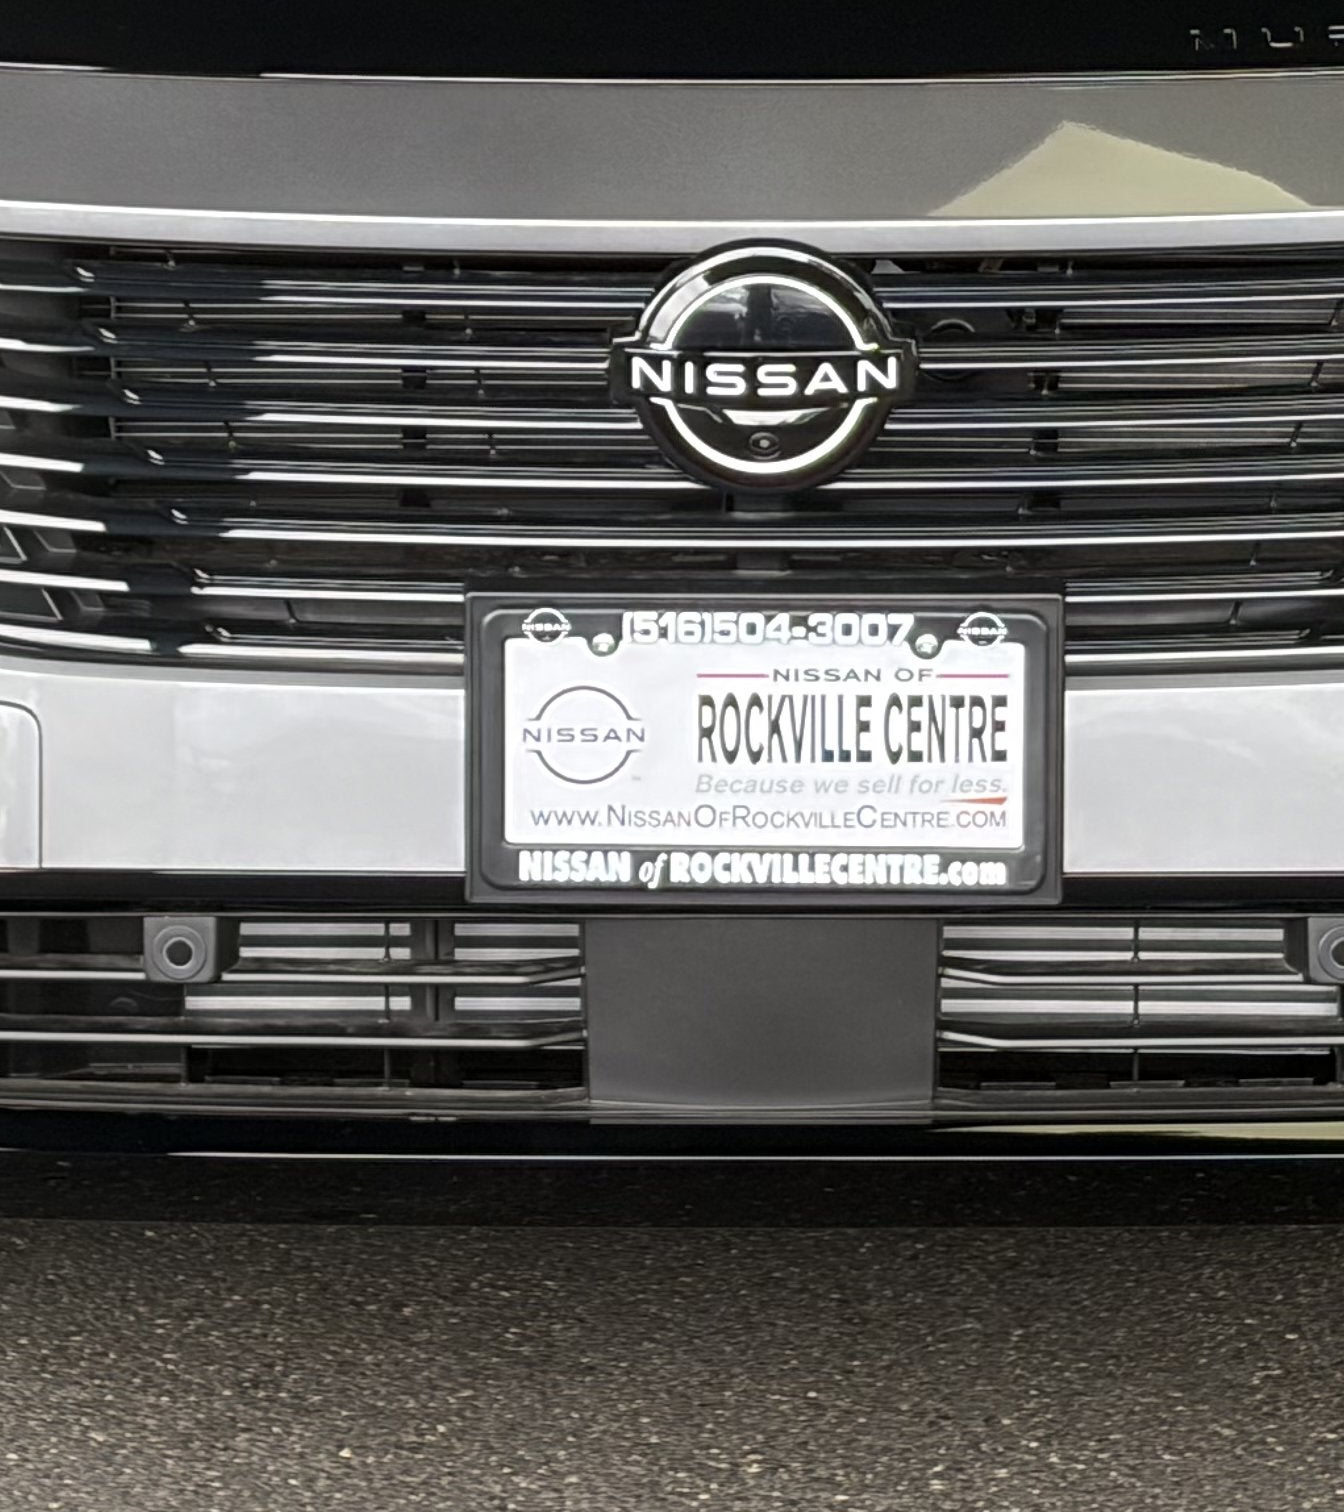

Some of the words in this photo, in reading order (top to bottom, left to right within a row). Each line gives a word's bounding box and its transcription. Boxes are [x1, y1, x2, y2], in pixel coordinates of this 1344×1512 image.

[631, 356, 898, 396] NISSAN
[773, 668, 881, 682] NISSAN
[894, 668, 933, 682] OF
[522, 727, 646, 743] NISSAN
[697, 692, 873, 764] ROCKVILLE
[884, 692, 1008, 764] CENTRE
[695, 774, 805, 794] Because
[814, 779, 850, 794] we
[856, 774, 903, 794] sell
[909, 774, 944, 794] for
[951, 774, 1007, 794] less.
[518, 850, 631, 882] NISSAN
[639, 853, 668, 889] of
[670, 851, 1006, 885] ROCKVILLECENTRE.com
